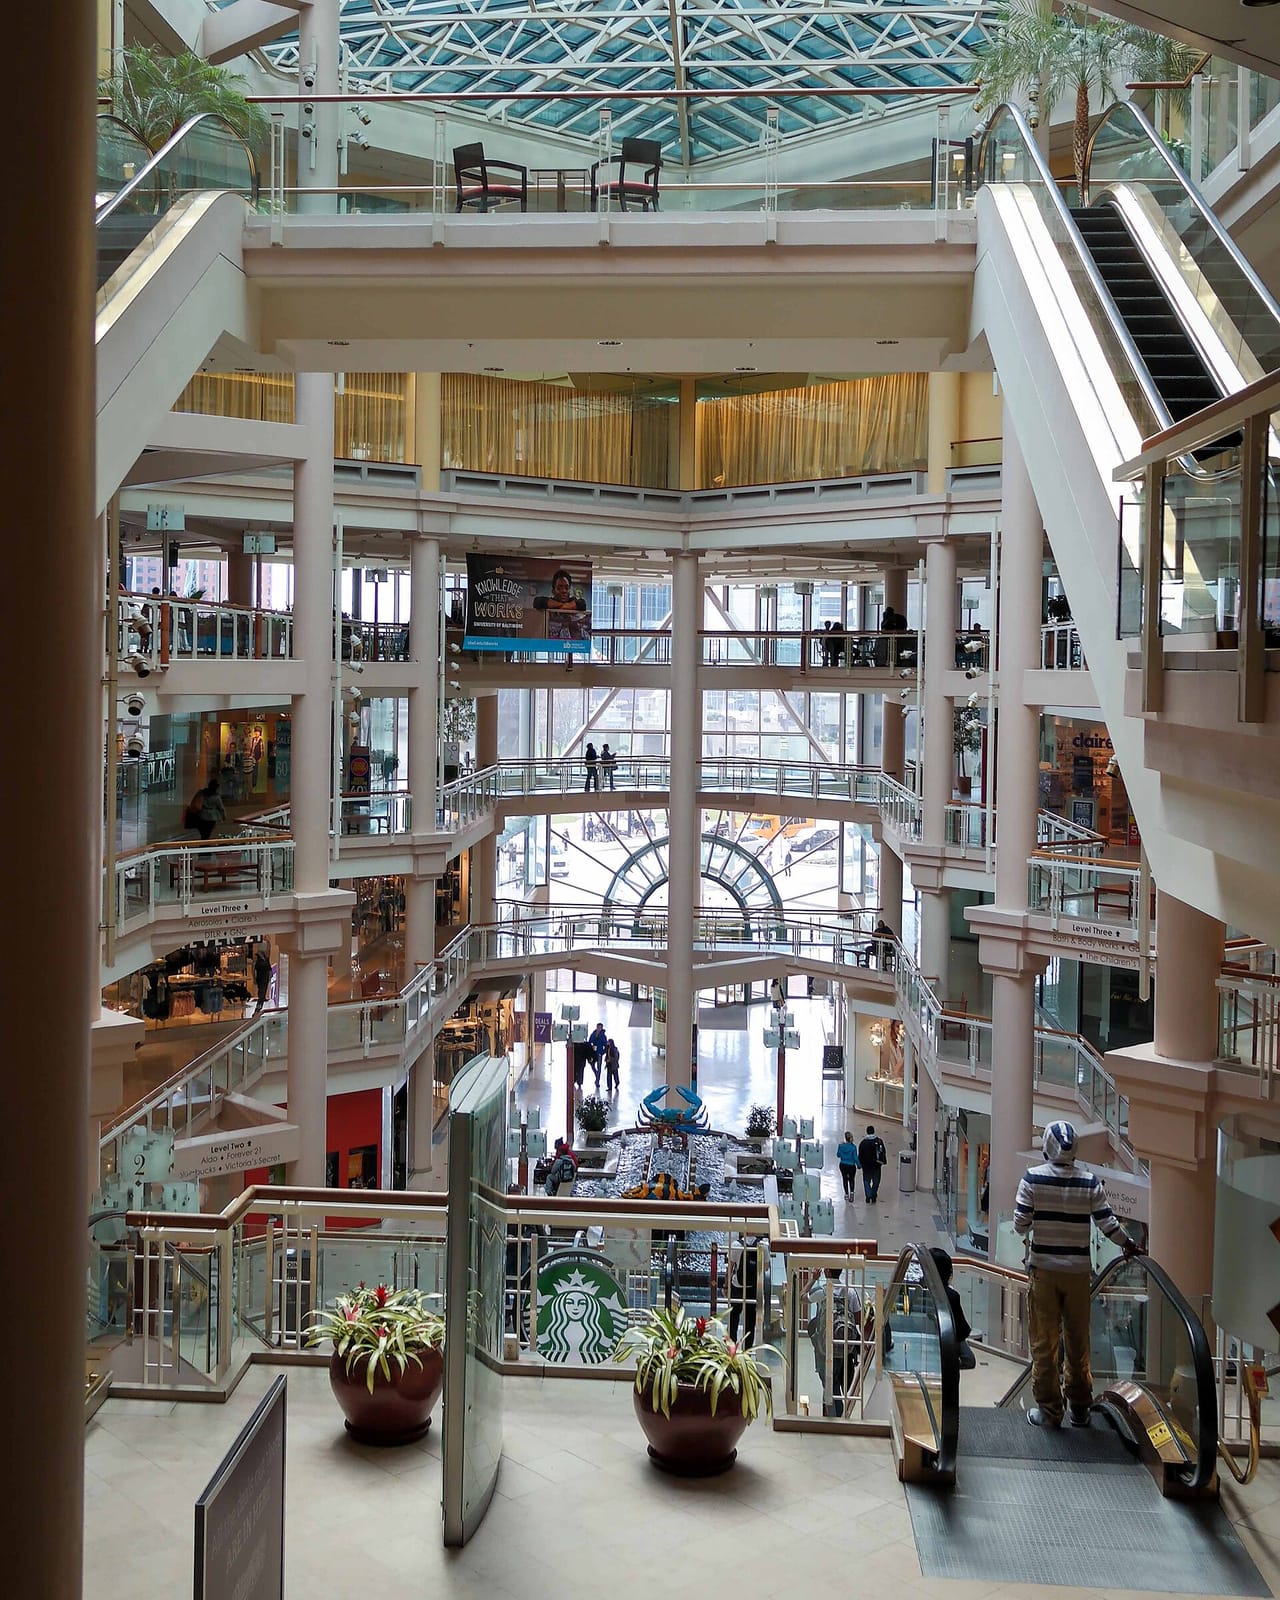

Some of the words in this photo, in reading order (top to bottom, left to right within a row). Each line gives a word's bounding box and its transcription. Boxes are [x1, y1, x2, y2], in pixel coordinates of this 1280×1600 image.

[474, 578, 524, 599] KNOWLEDGE
[490, 593, 508, 602] THAT
[474, 601, 524, 619] WORKS
[201, 905, 220, 914] Level
[222, 904, 241, 912] Three
[188, 918, 223, 928] Aerosoles
[230, 928, 247, 937] GNC
[1072, 924, 1091, 934] Level
[1093, 926, 1113, 937] Three
[210, 1142, 230, 1153] Level
[231, 1141, 244, 1149] Two
[201, 1156, 217, 1164] Aldo
[226, 1150, 253, 1160] Forever
[254, 1147, 262, 1155] 21
[134, 1153, 145, 1176] 2
[225, 1158, 258, 1170] Victoria's
[259, 1154, 280, 1164] Secret
[1121, 1193, 1137, 1203] Seal
[1119, 1204, 1132, 1214] Hut
